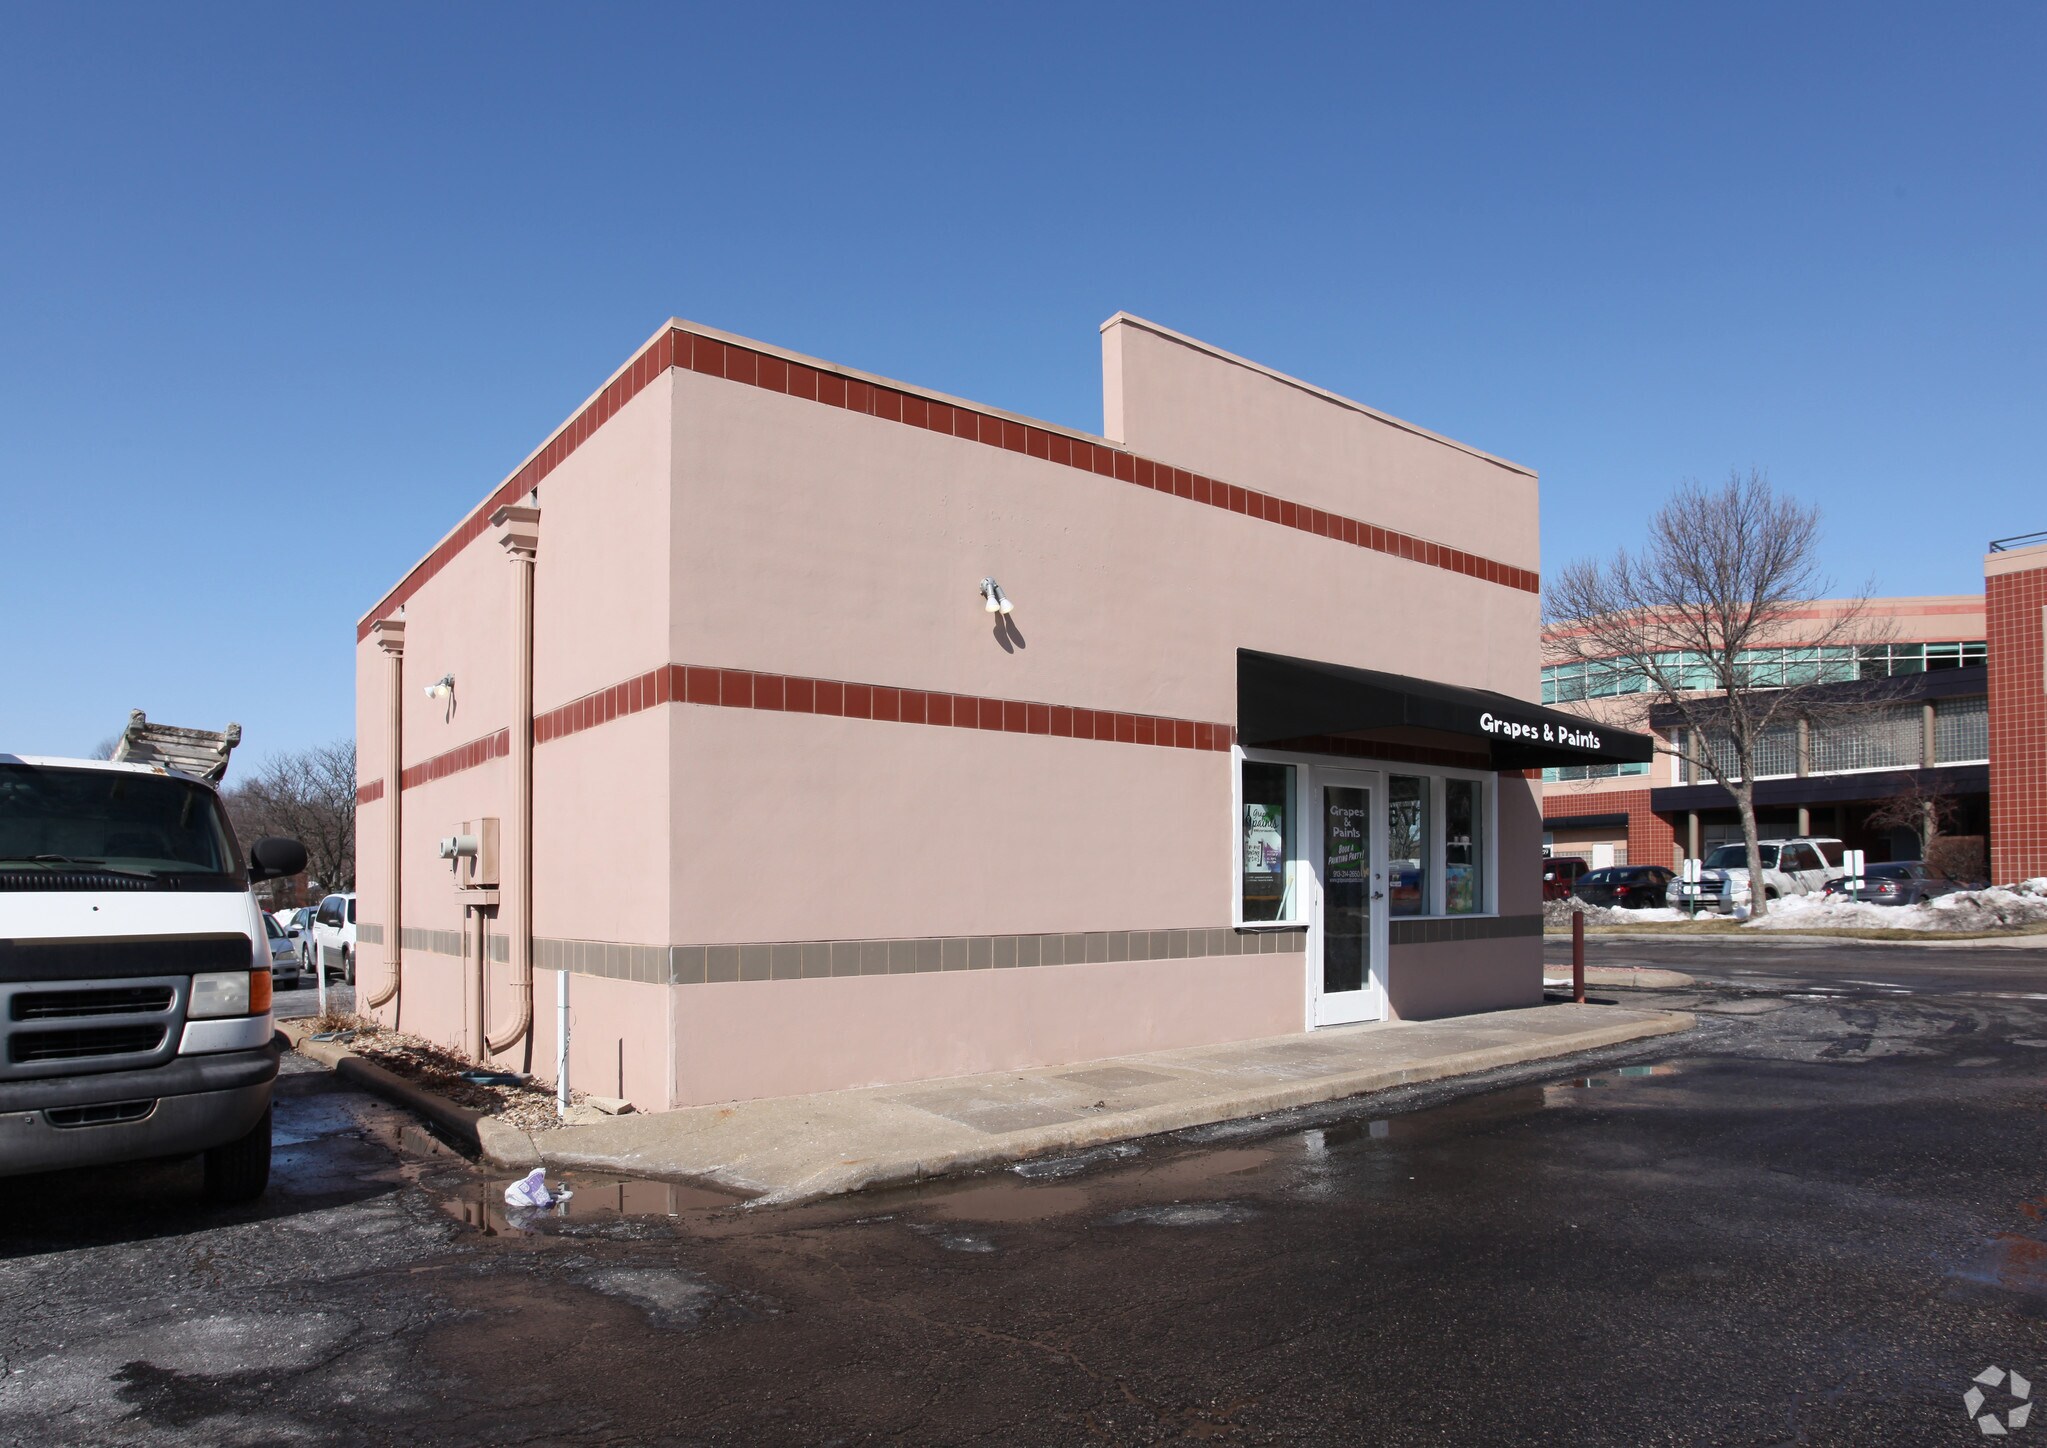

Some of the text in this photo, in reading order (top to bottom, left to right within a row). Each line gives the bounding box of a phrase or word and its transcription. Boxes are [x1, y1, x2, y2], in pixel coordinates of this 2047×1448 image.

[1479, 712, 1601, 749] Grapes & Paints
[1329, 805, 1365, 817] Grapes
[1343, 817, 1351, 827] &
[1333, 826, 1361, 838] Paints
